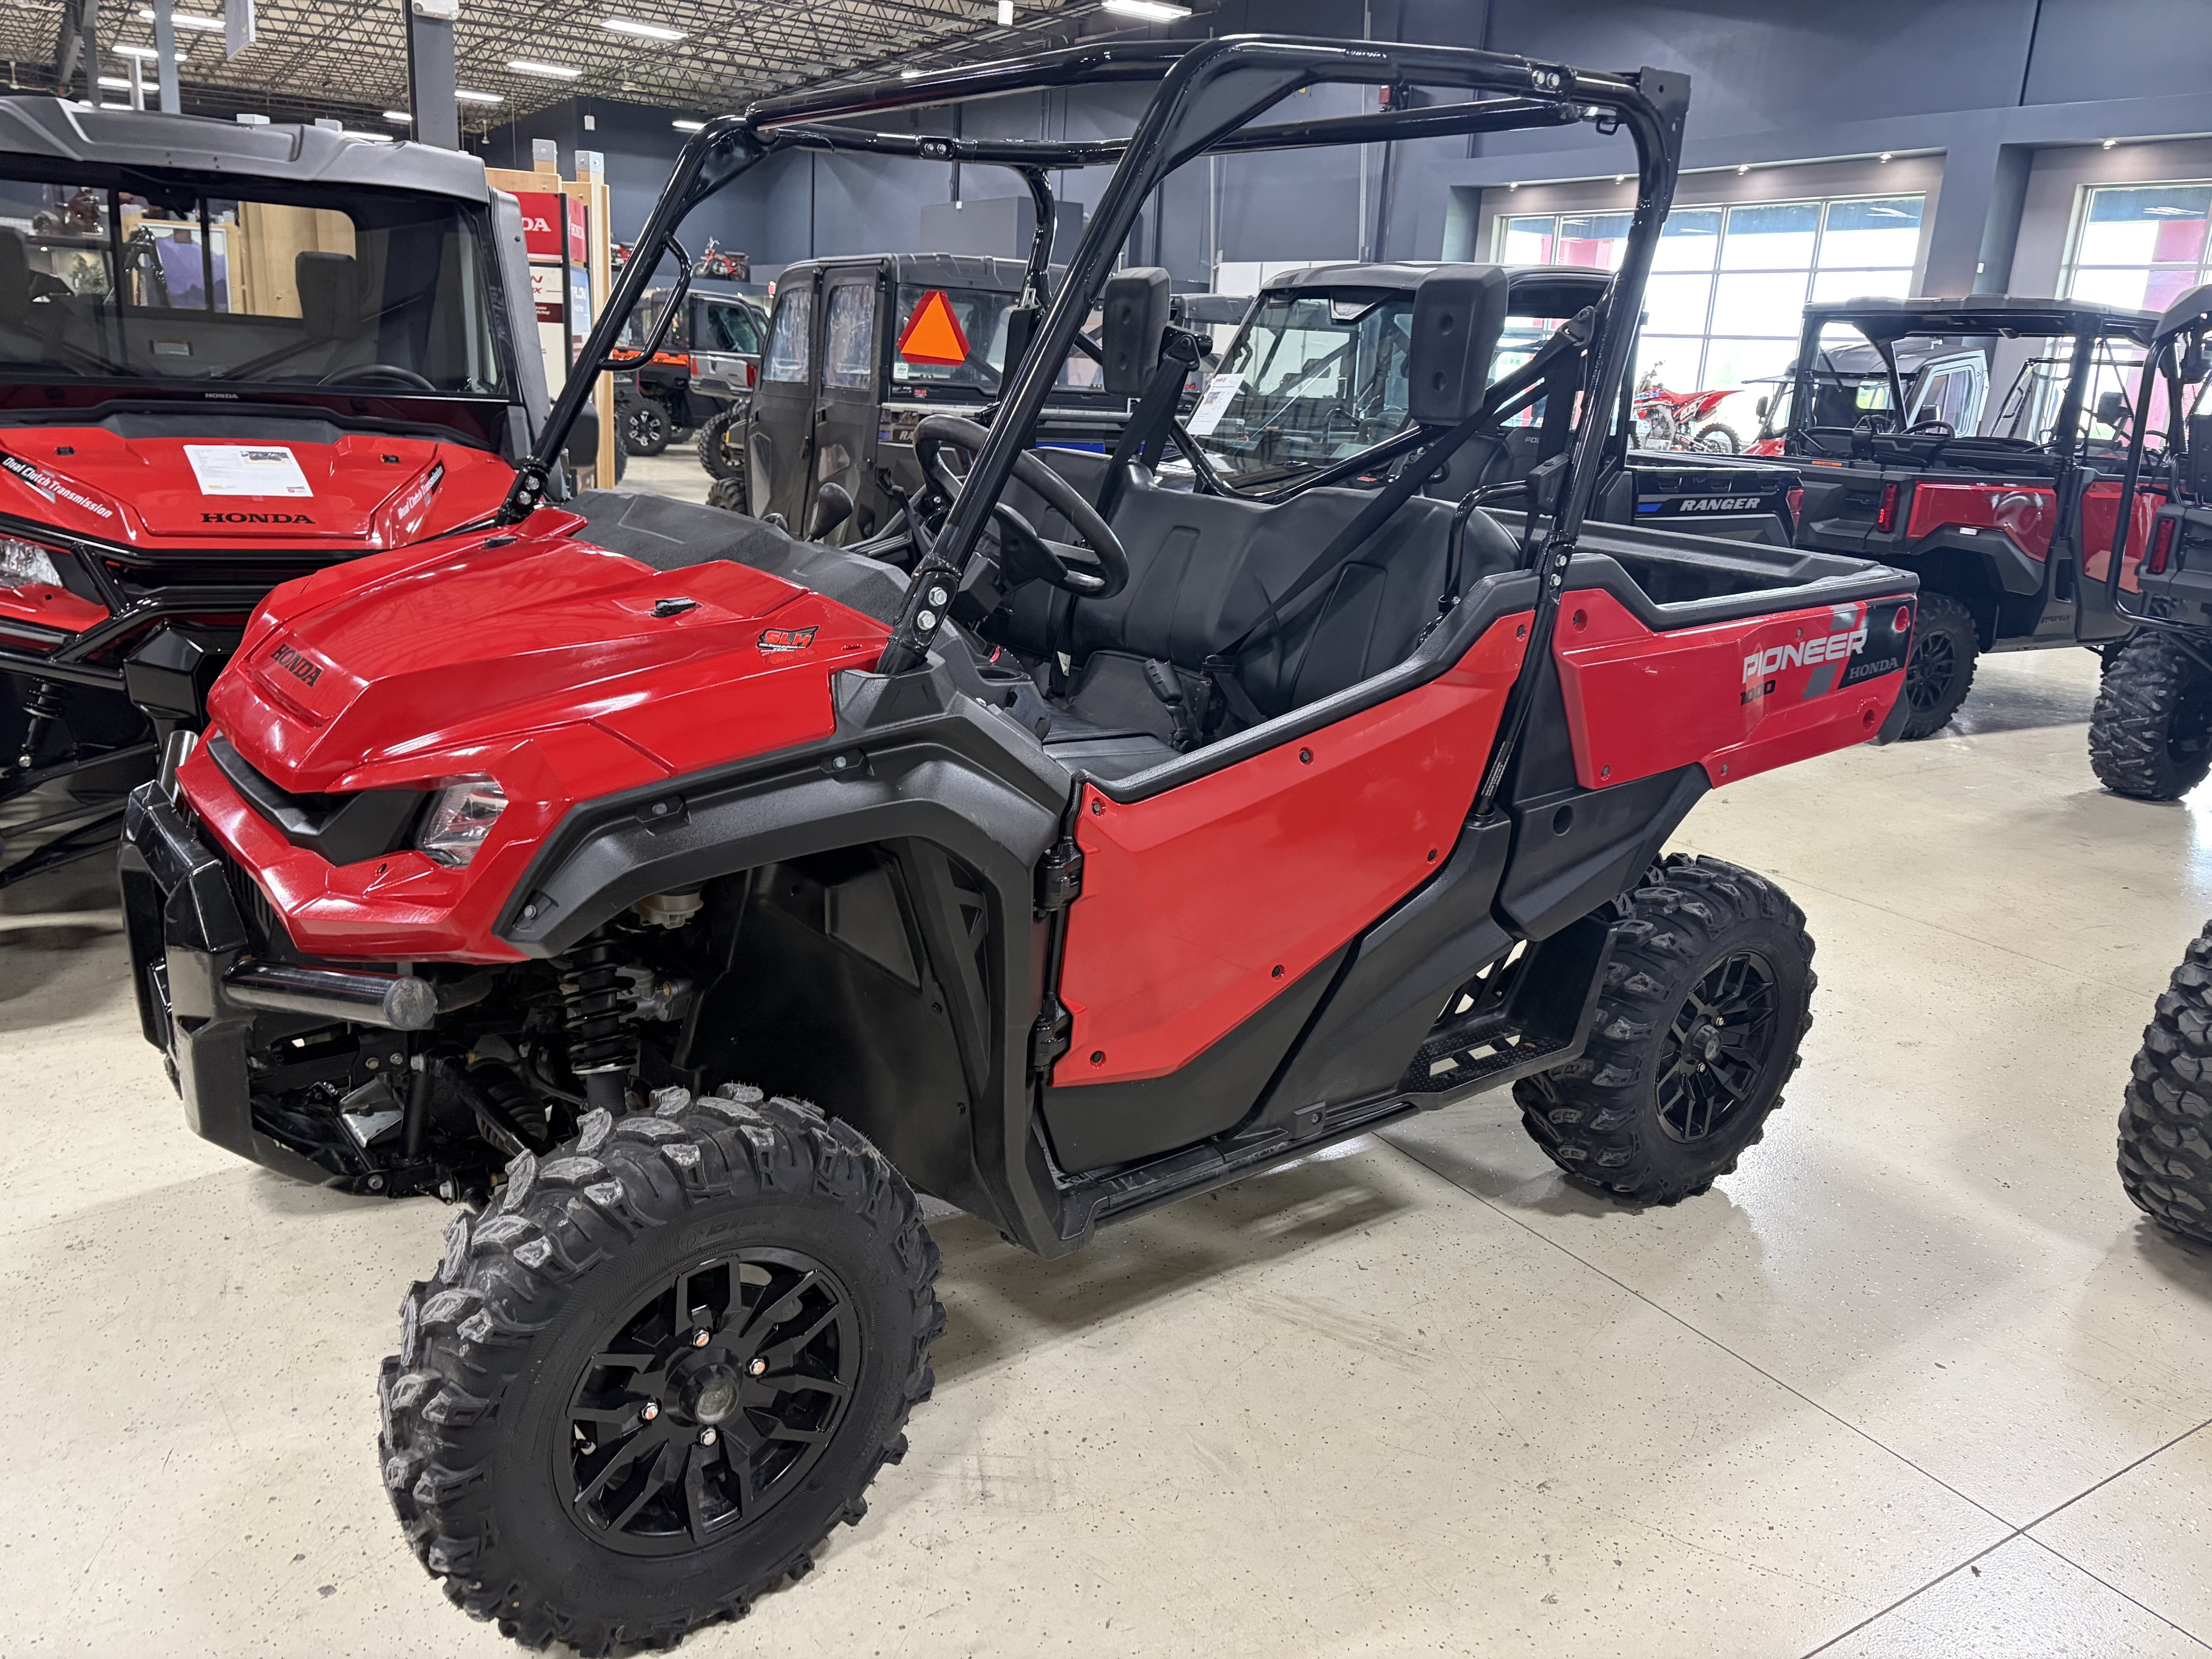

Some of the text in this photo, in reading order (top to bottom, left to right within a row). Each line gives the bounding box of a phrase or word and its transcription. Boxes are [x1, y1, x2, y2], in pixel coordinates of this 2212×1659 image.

[2, 457, 113, 519] Dual Clutch Transmission
[1679, 498, 1761, 512] RANGER
[200, 513, 316, 524] HONDA
[765, 631, 812, 646] SLH
[270, 643, 323, 687] HONDA
[1742, 629, 1869, 684] PIONEER
[1848, 657, 1899, 680] HONDA
[1740, 679, 1776, 706] 1000
